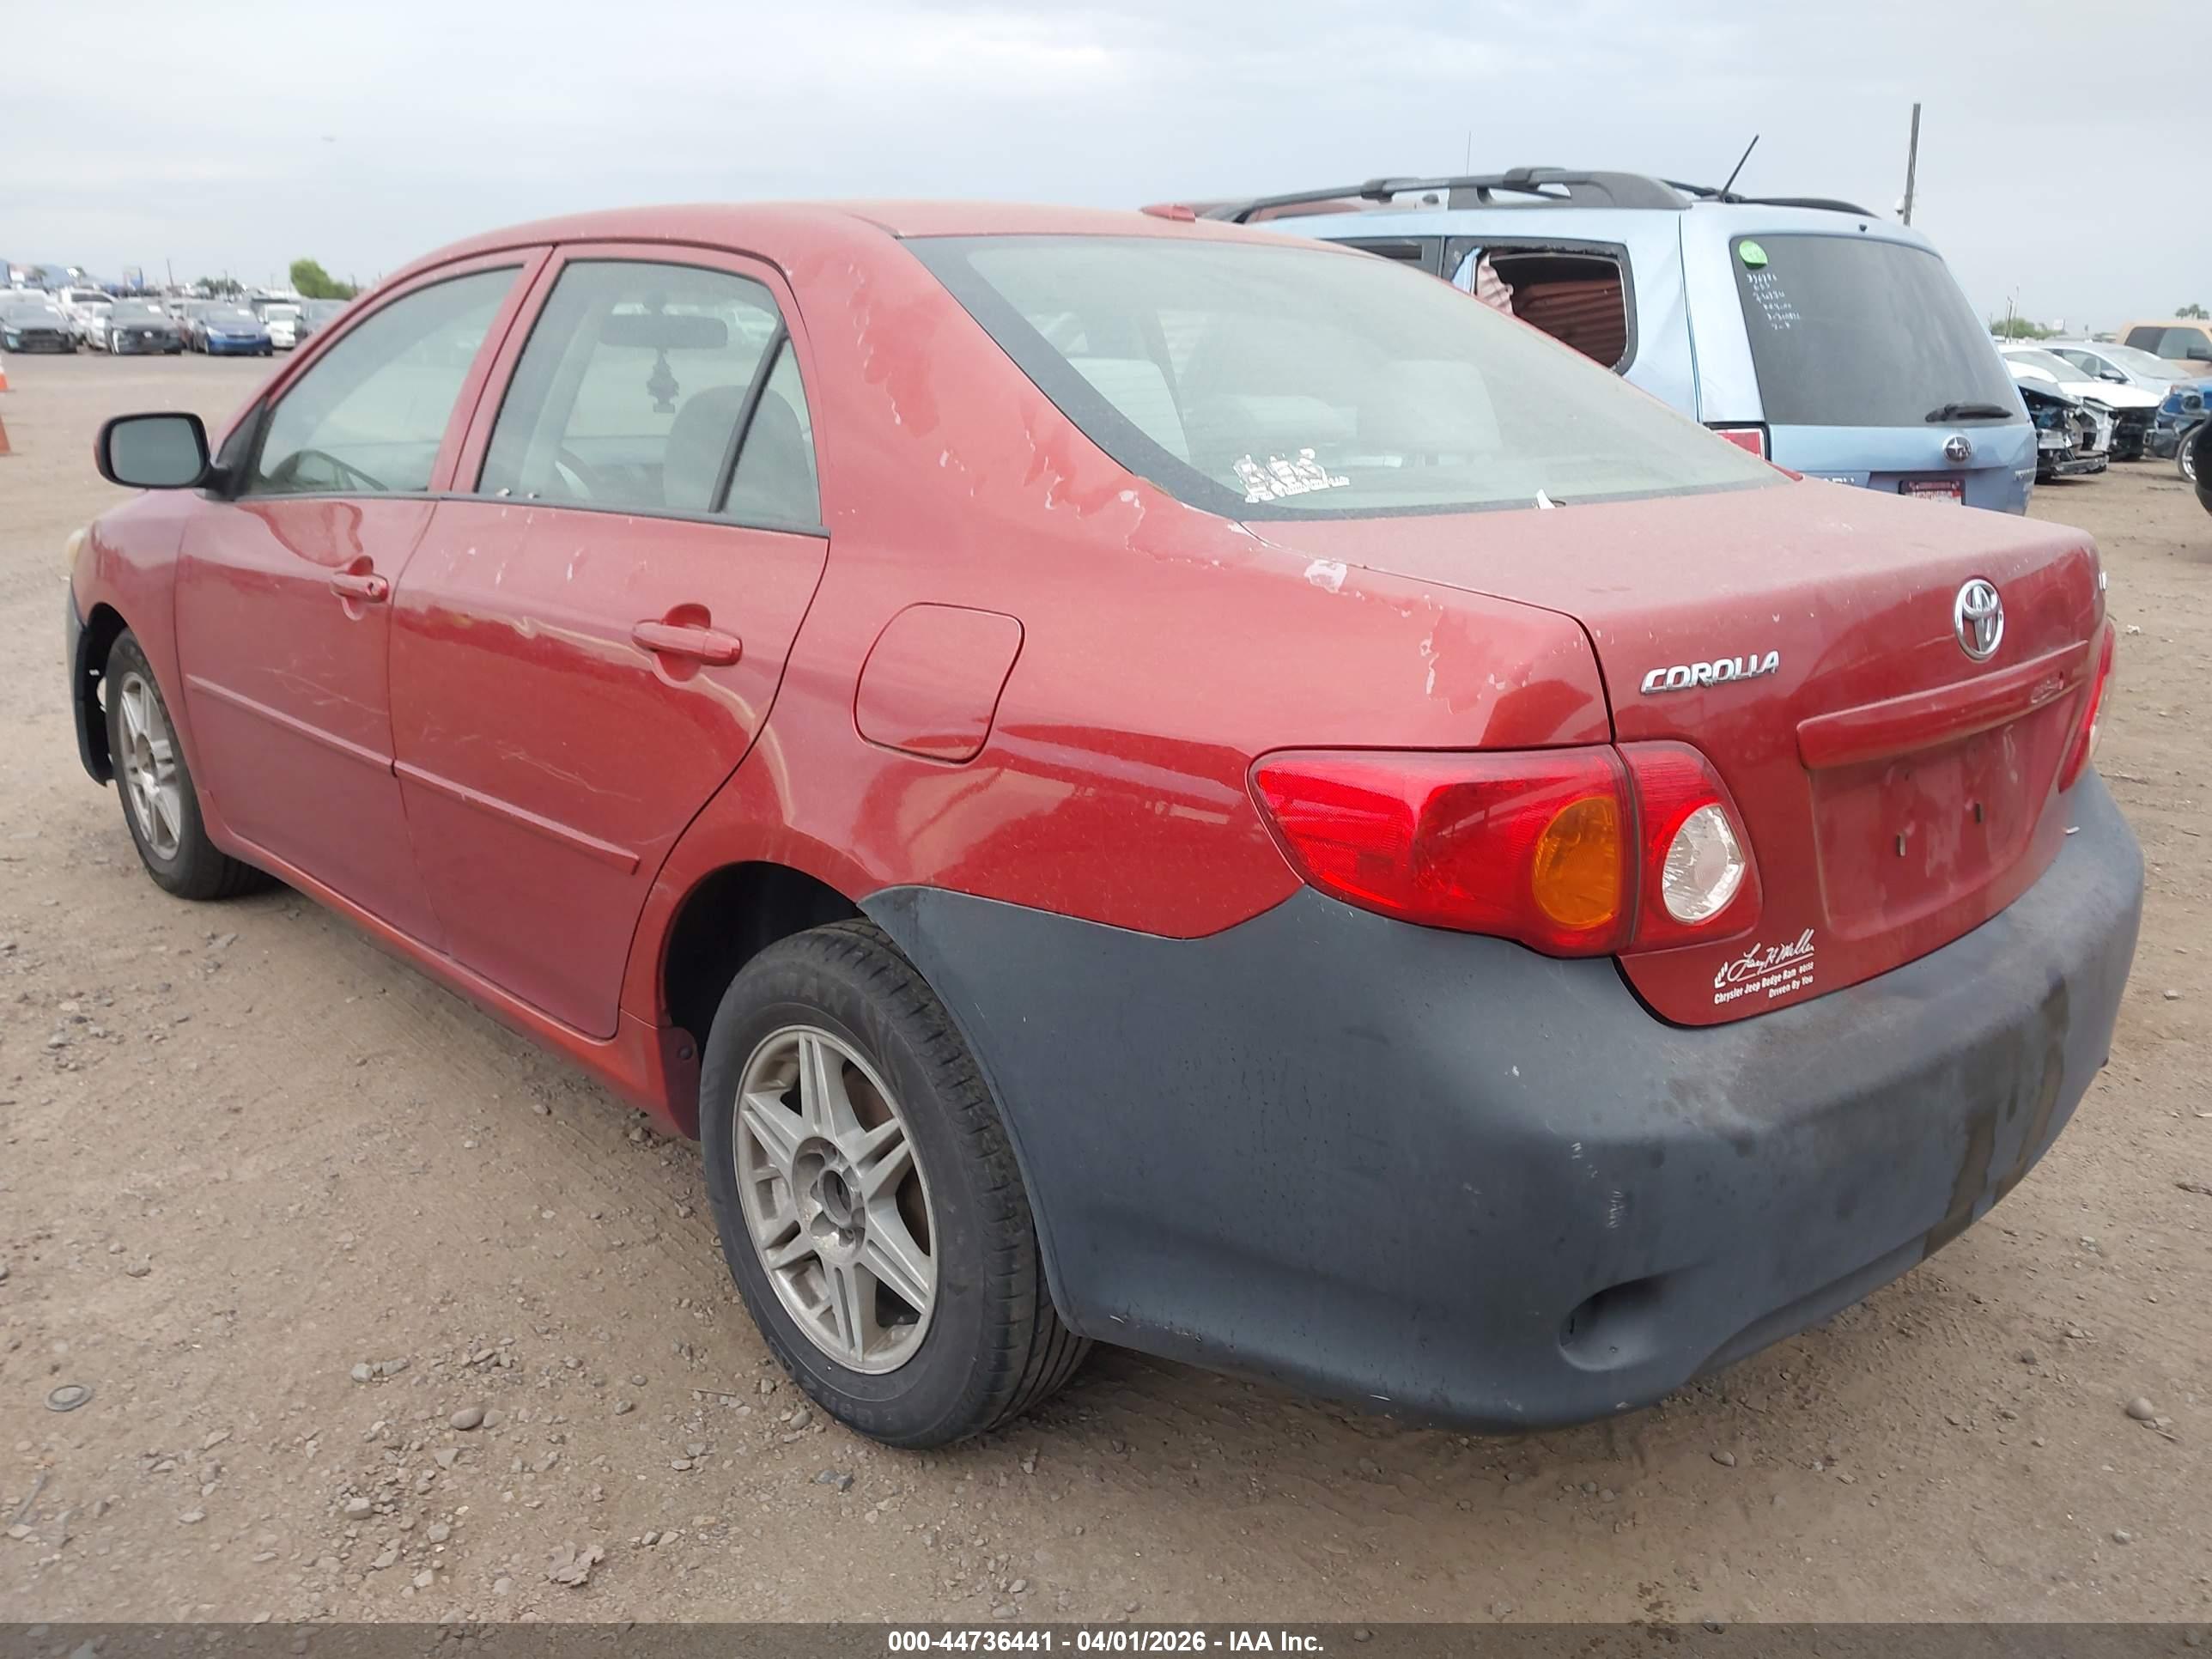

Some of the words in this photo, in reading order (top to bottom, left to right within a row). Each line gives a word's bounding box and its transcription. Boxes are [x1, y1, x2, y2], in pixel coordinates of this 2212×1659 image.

[1641, 650, 1780, 694] COROLLA
[1714, 987, 1743, 1005] Chrysler
[1744, 981, 1760, 994] Jeep
[1761, 973, 1783, 988] Dodge
[1783, 969, 1797, 981] Ram
[1769, 984, 1791, 999] Driven
